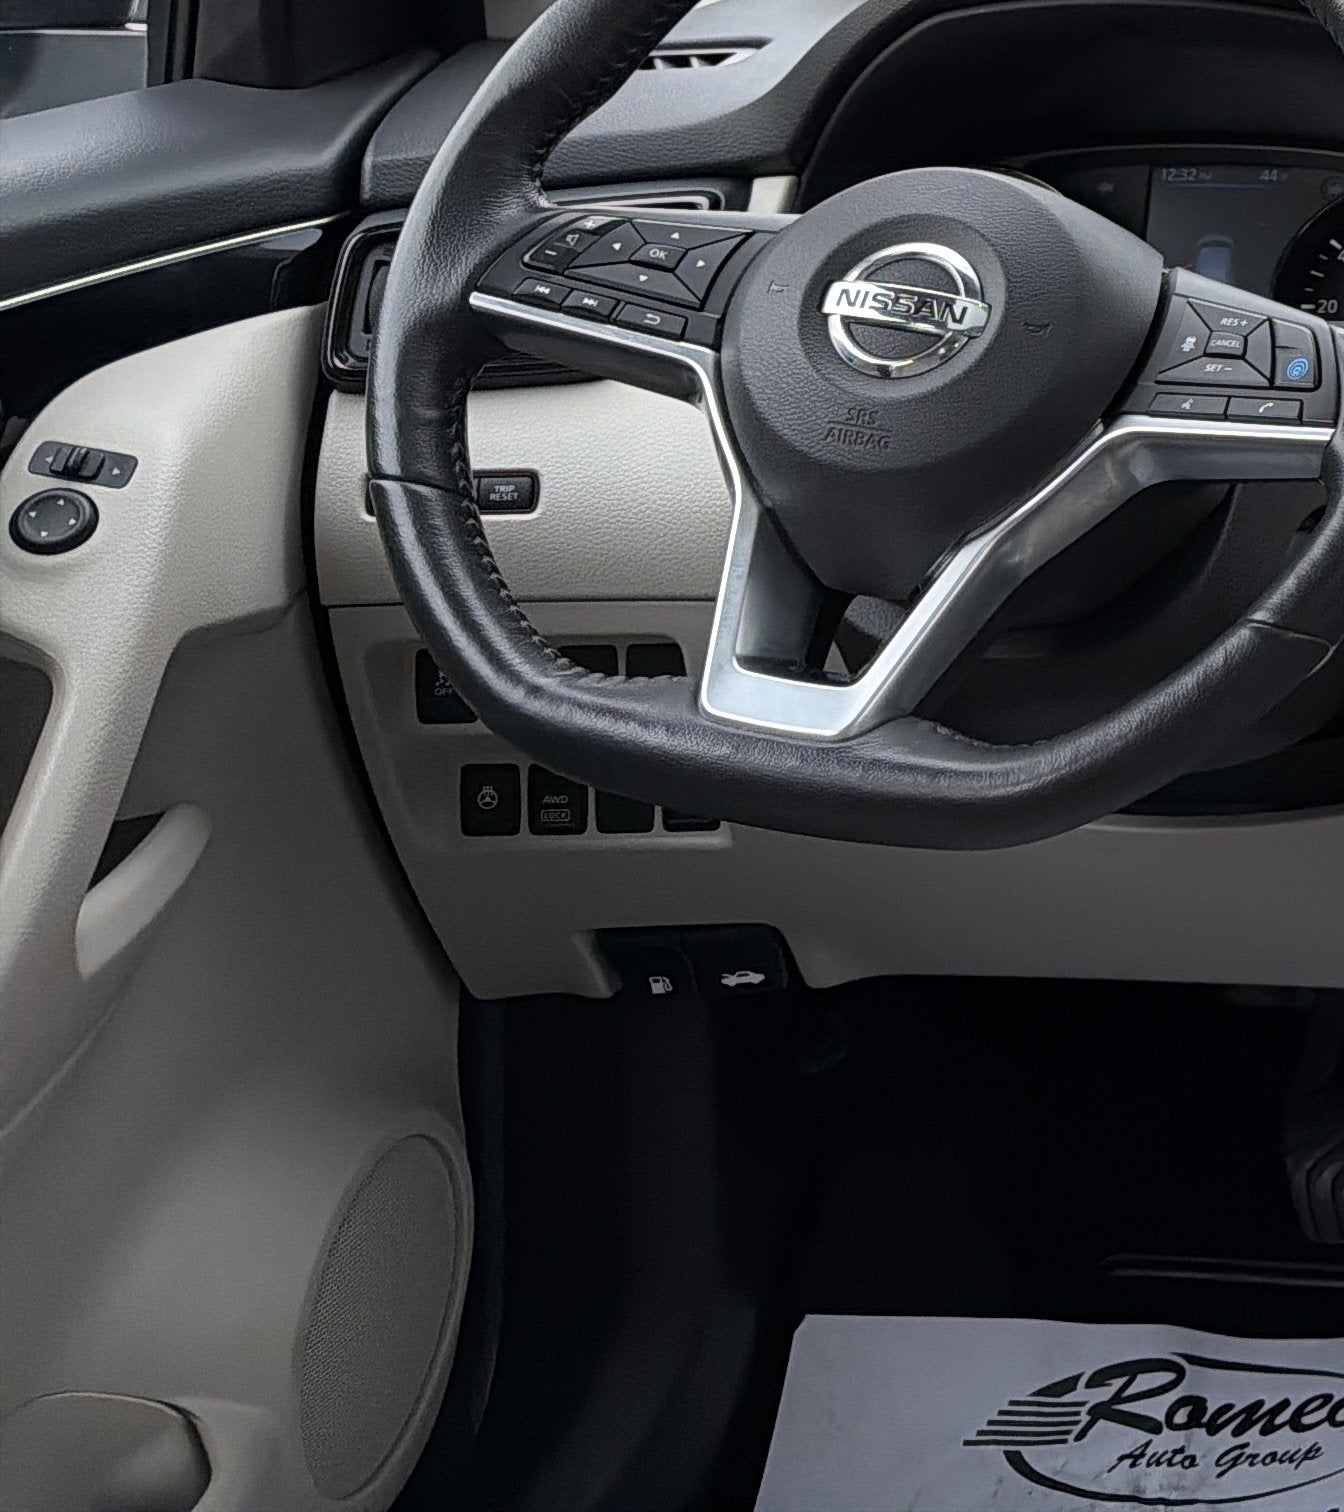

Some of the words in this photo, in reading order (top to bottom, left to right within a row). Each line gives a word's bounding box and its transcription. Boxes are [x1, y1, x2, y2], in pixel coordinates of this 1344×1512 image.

[648, 248, 668, 260] OK
[835, 288, 969, 326] NISSAN
[1316, 299, 1338, 314] 20
[1210, 339, 1242, 348] CANCEL
[845, 406, 880, 426] SRS
[823, 426, 893, 450] AIRBAG
[493, 484, 516, 493] TRIP
[489, 492, 519, 502] RESET
[542, 794, 569, 804] AWD
[1106, 1438, 1201, 1475] Auto
[1215, 1439, 1326, 1479] Group
